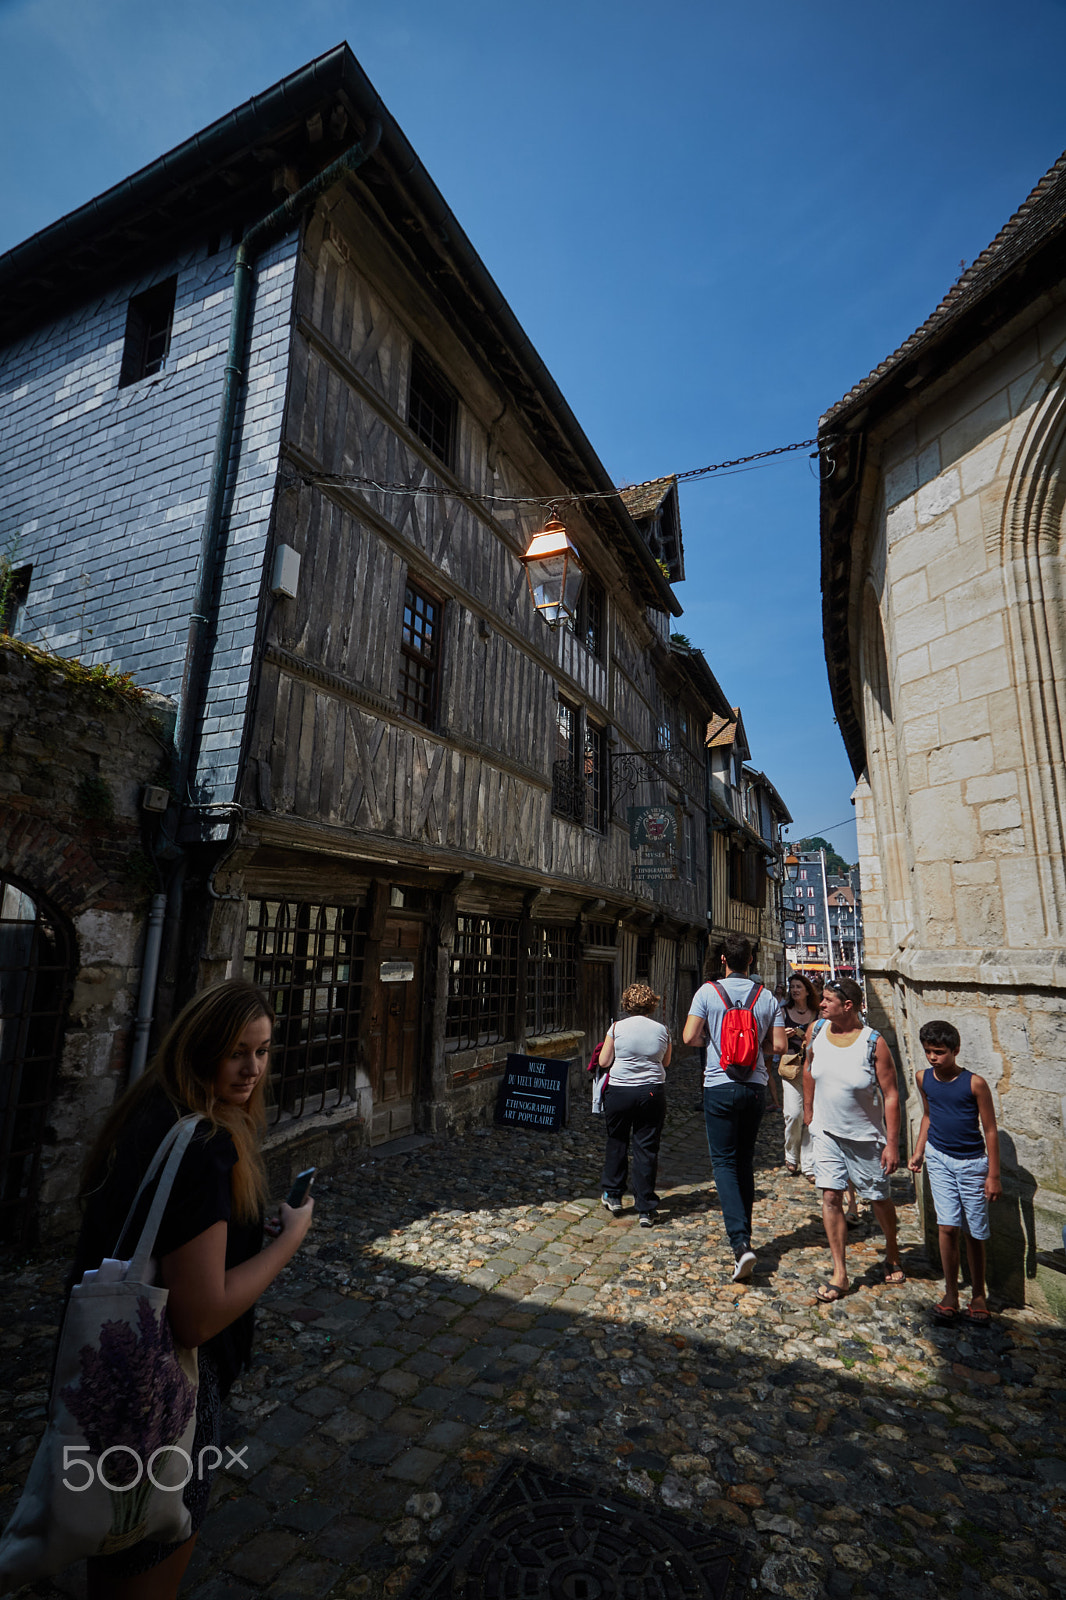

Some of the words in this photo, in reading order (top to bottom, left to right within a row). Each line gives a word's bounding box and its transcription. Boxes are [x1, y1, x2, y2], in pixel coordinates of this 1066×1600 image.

[507, 1073, 516, 1085] DU
[518, 1075, 533, 1087] VIEUX
[533, 1077, 561, 1091] HONFLEUR
[505, 1098, 556, 1114] ETHNOGRAPHIE
[503, 1110, 516, 1119] ART
[518, 1111, 554, 1125] POPULAIRE
